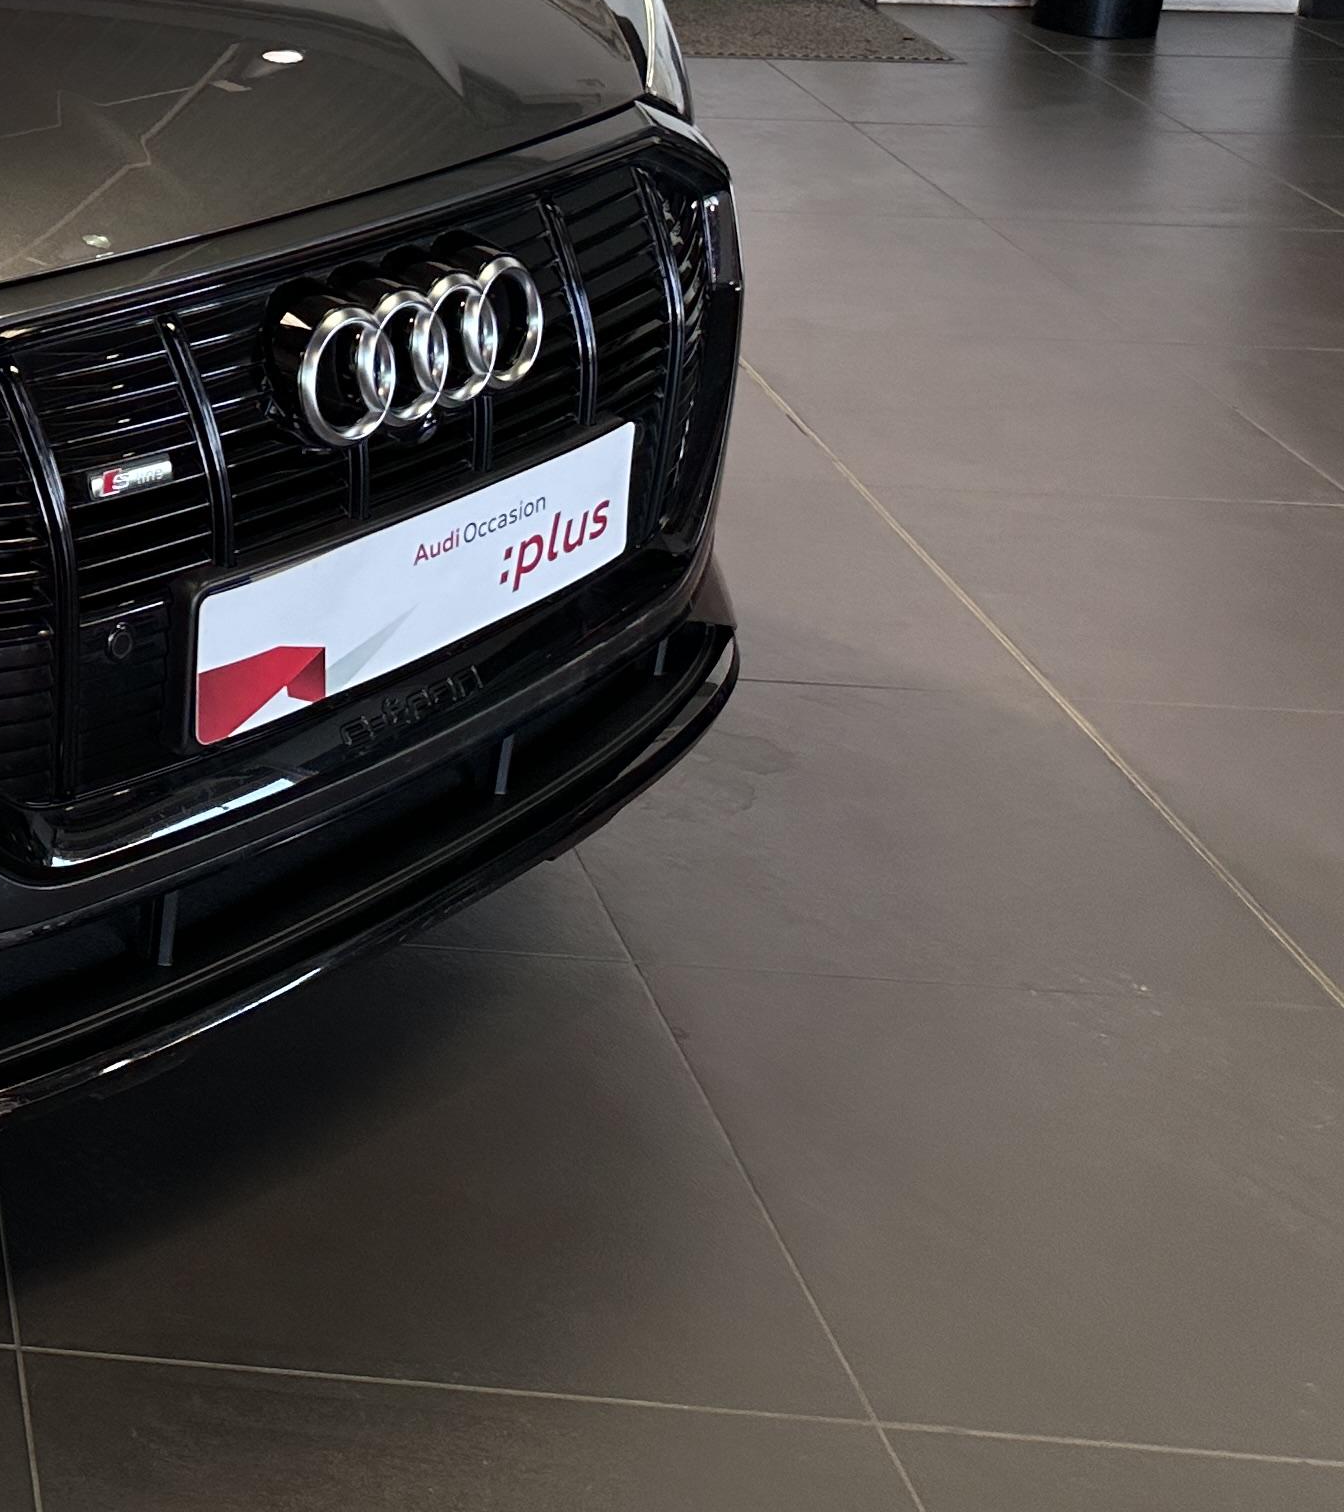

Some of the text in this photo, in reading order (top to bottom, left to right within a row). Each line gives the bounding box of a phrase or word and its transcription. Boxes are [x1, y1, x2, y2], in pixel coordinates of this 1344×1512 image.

[413, 496, 546, 566] Audi Occasion
[499, 499, 610, 593] :plus
